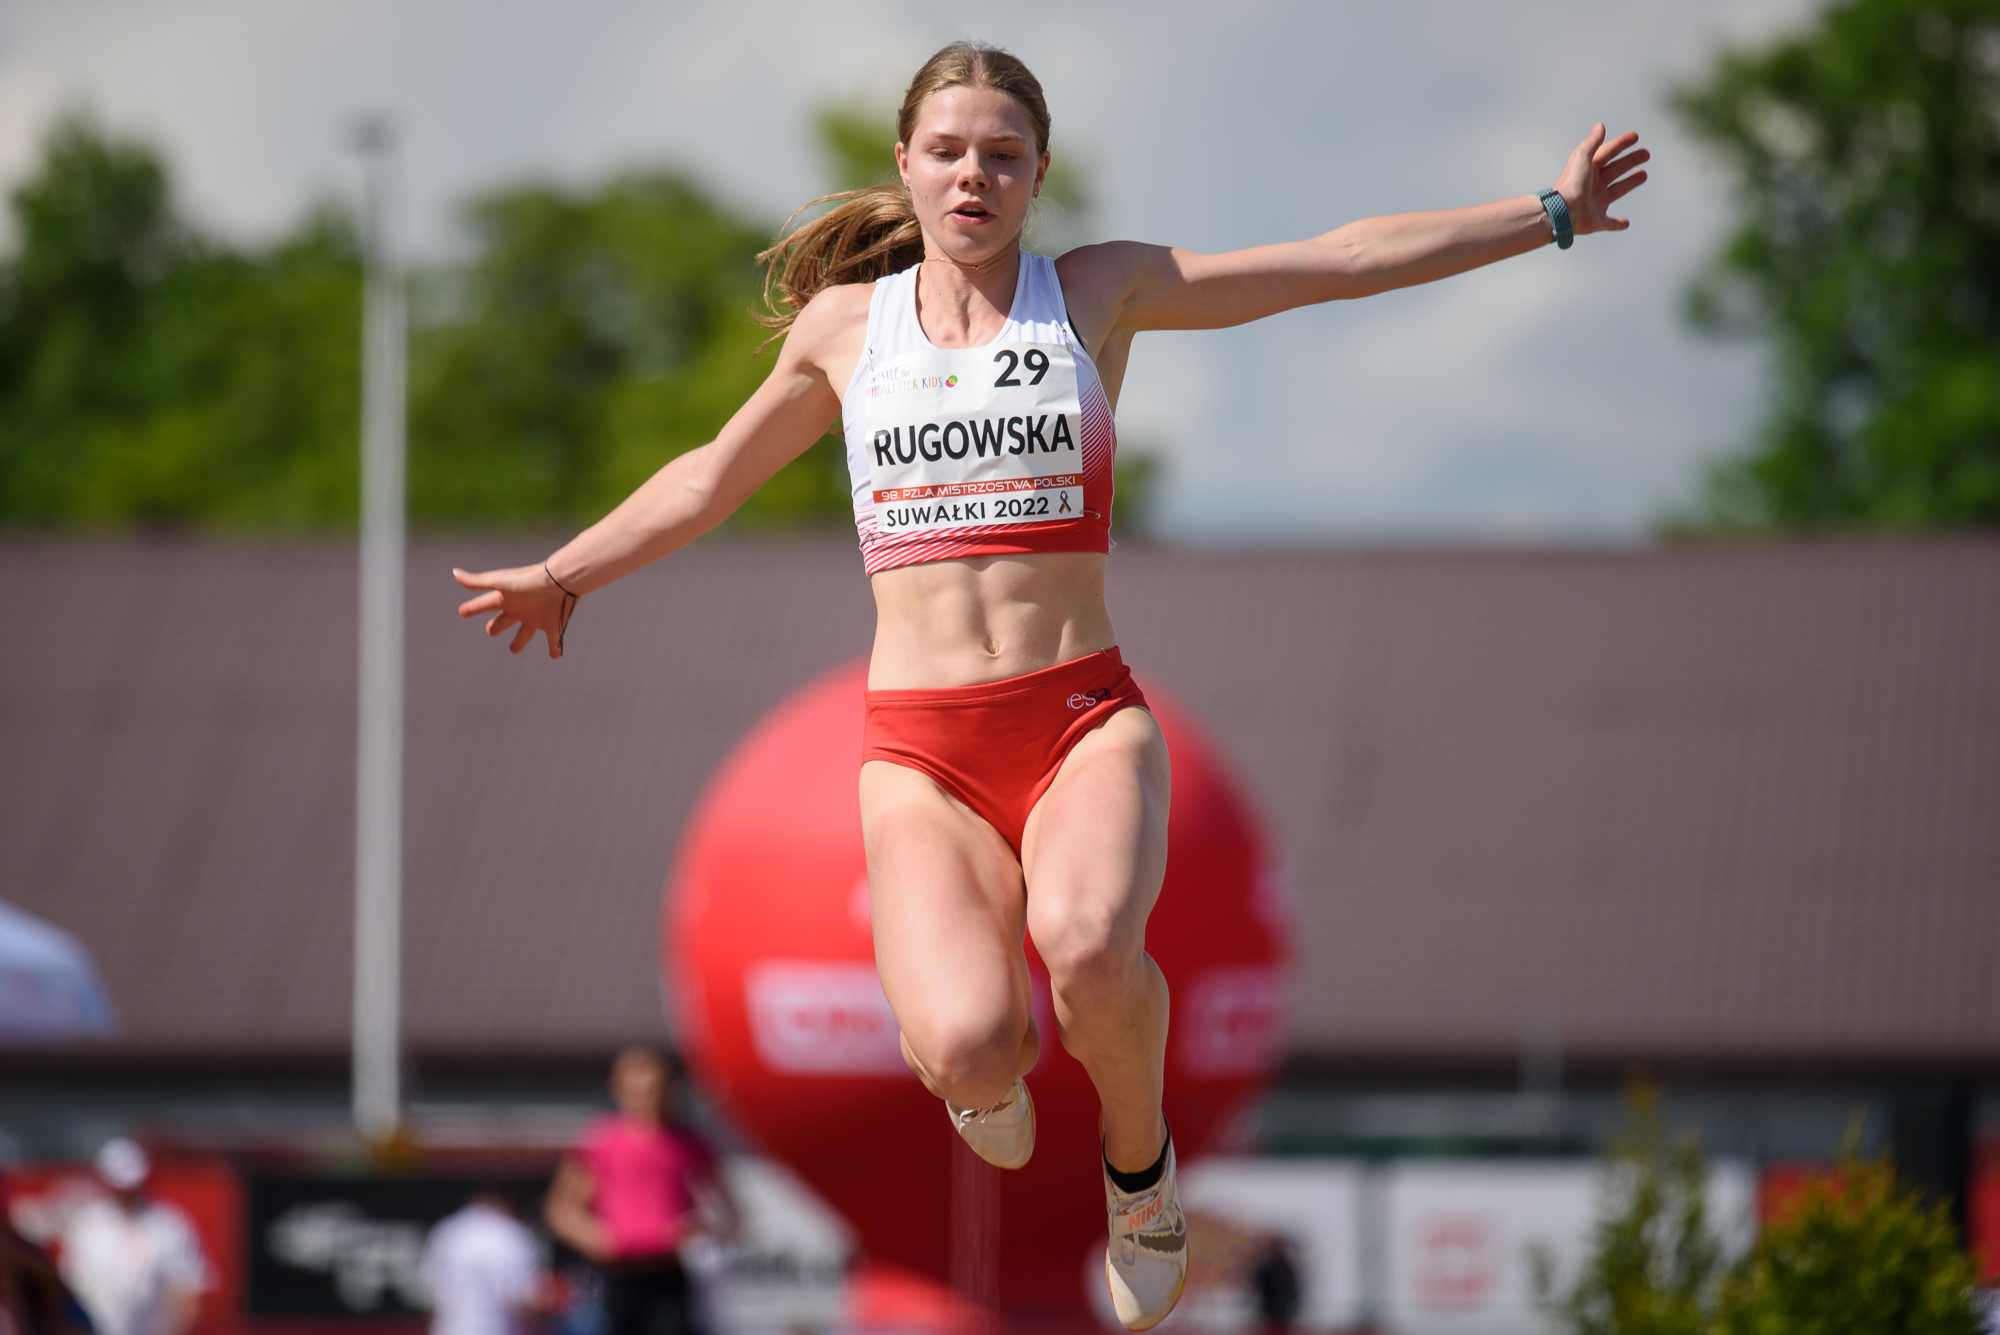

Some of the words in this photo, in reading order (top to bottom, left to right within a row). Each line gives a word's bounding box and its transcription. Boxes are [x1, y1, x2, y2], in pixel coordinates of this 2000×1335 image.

[922, 376, 944, 389] KIDS
[993, 348, 1050, 388] 29
[874, 413, 1075, 467] RUGOWSKA
[881, 491, 900, 501] 98.
[902, 487, 934, 499] PZLA
[937, 477, 1032, 496] MISTRZOSTWA
[1034, 475, 1076, 488] POLSKI
[886, 501, 986, 527] SUWAŁKI
[994, 496, 1050, 518] 2022
[1128, 1193, 1163, 1231] NIKE
